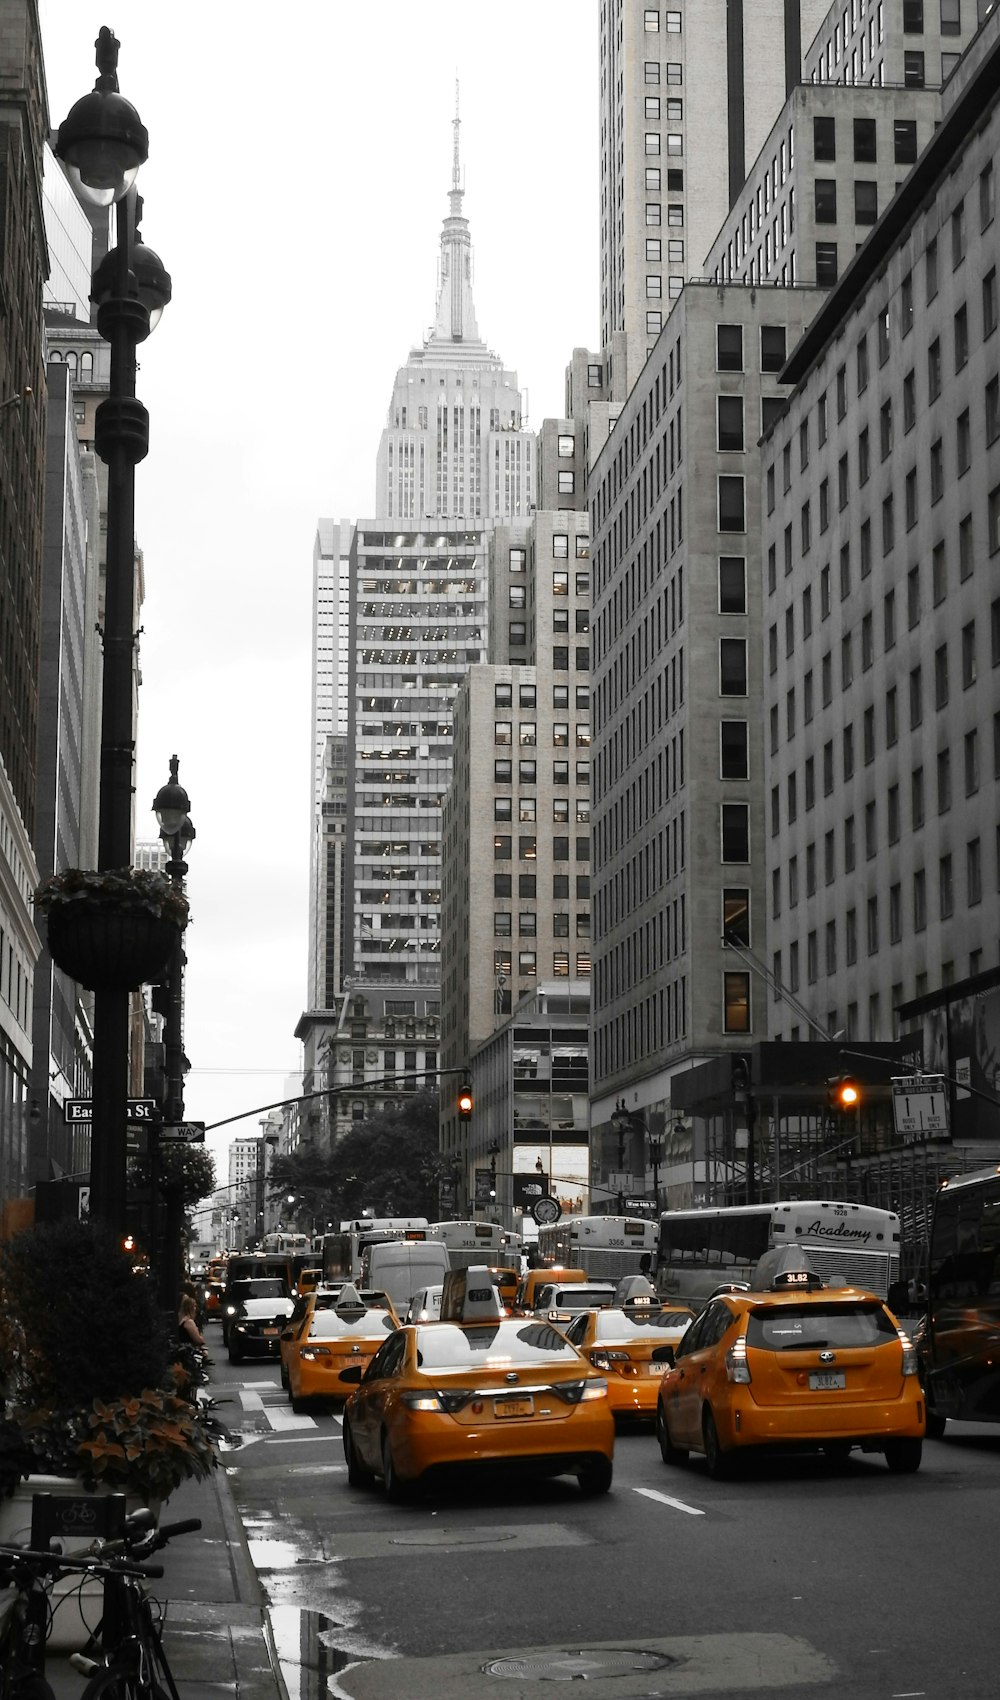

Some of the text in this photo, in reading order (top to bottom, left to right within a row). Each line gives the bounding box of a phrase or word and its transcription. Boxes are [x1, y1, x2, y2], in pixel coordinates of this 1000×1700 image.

[71, 1106, 93, 1118] Eas
[135, 1104, 150, 1118] St
[178, 1128, 197, 1136] WAY
[833, 1209, 848, 1217] 1928
[807, 1220, 872, 1244] Academy
[787, 1273, 808, 1282] 3L82
